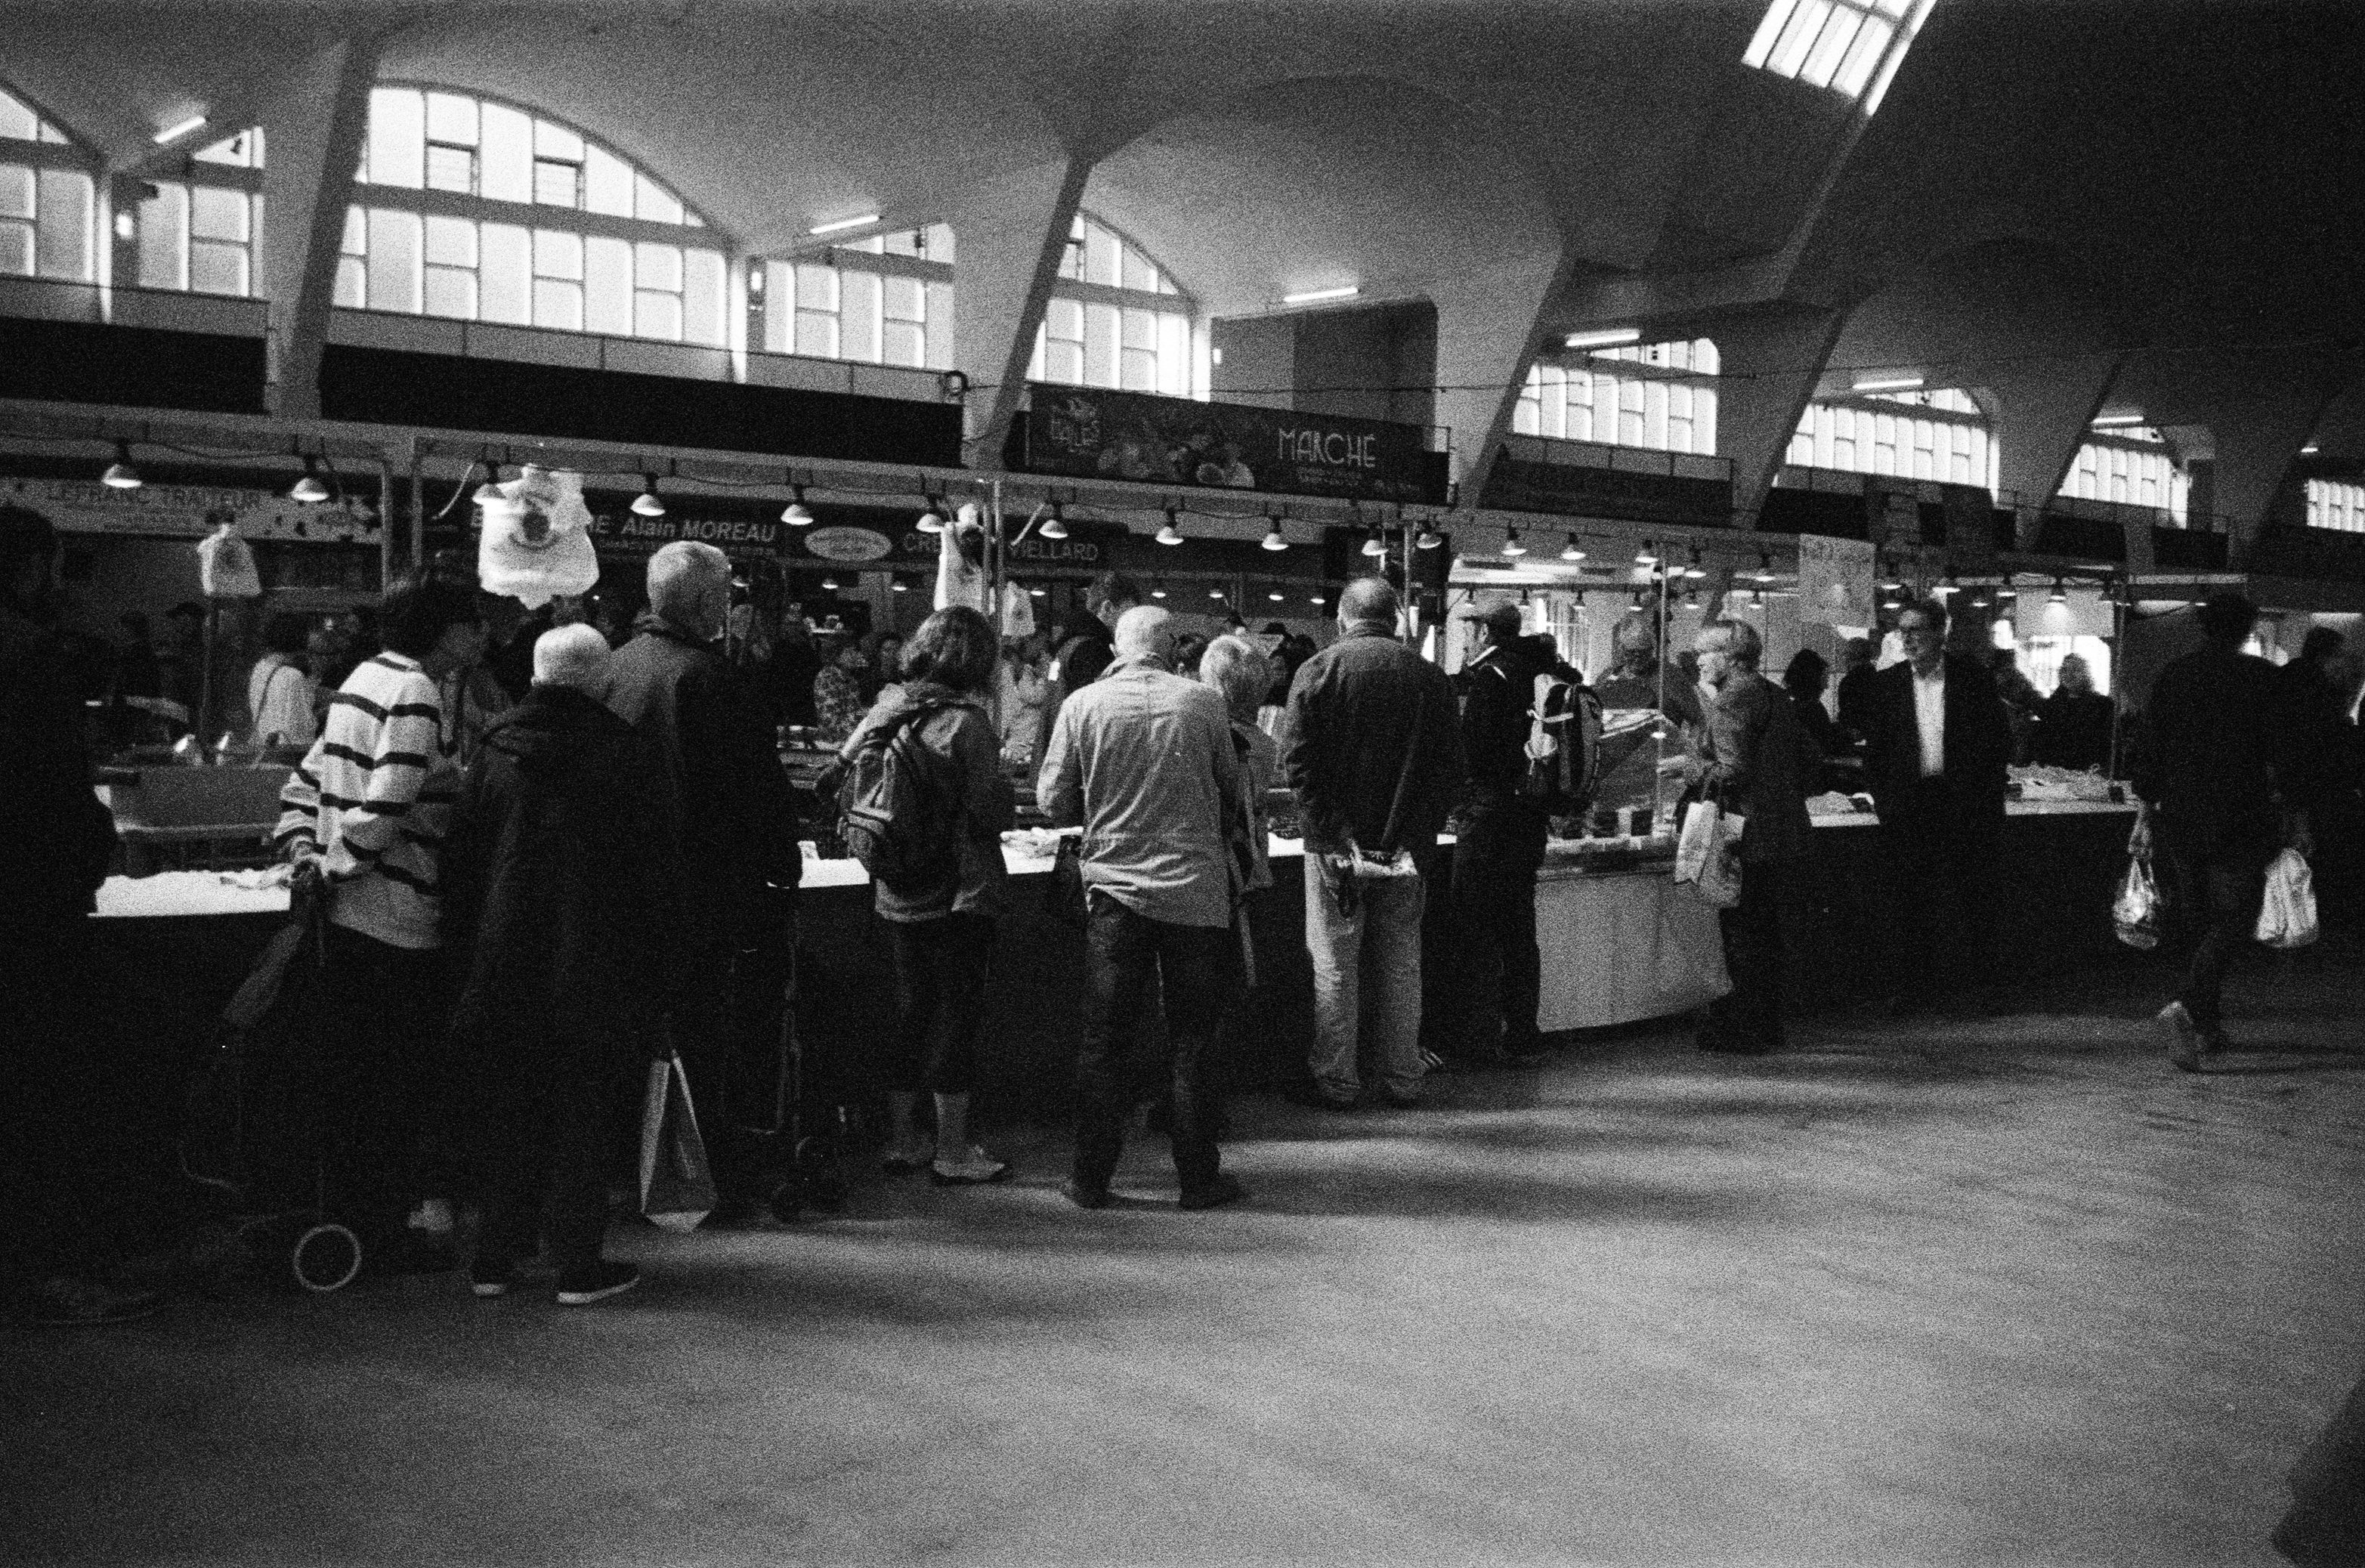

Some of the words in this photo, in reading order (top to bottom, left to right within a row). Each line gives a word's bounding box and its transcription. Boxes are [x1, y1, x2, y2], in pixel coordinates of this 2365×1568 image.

[161, 486, 260, 509] TRAITEUR
[621, 518, 675, 537] Alain
[682, 520, 776, 543] MOREAU
